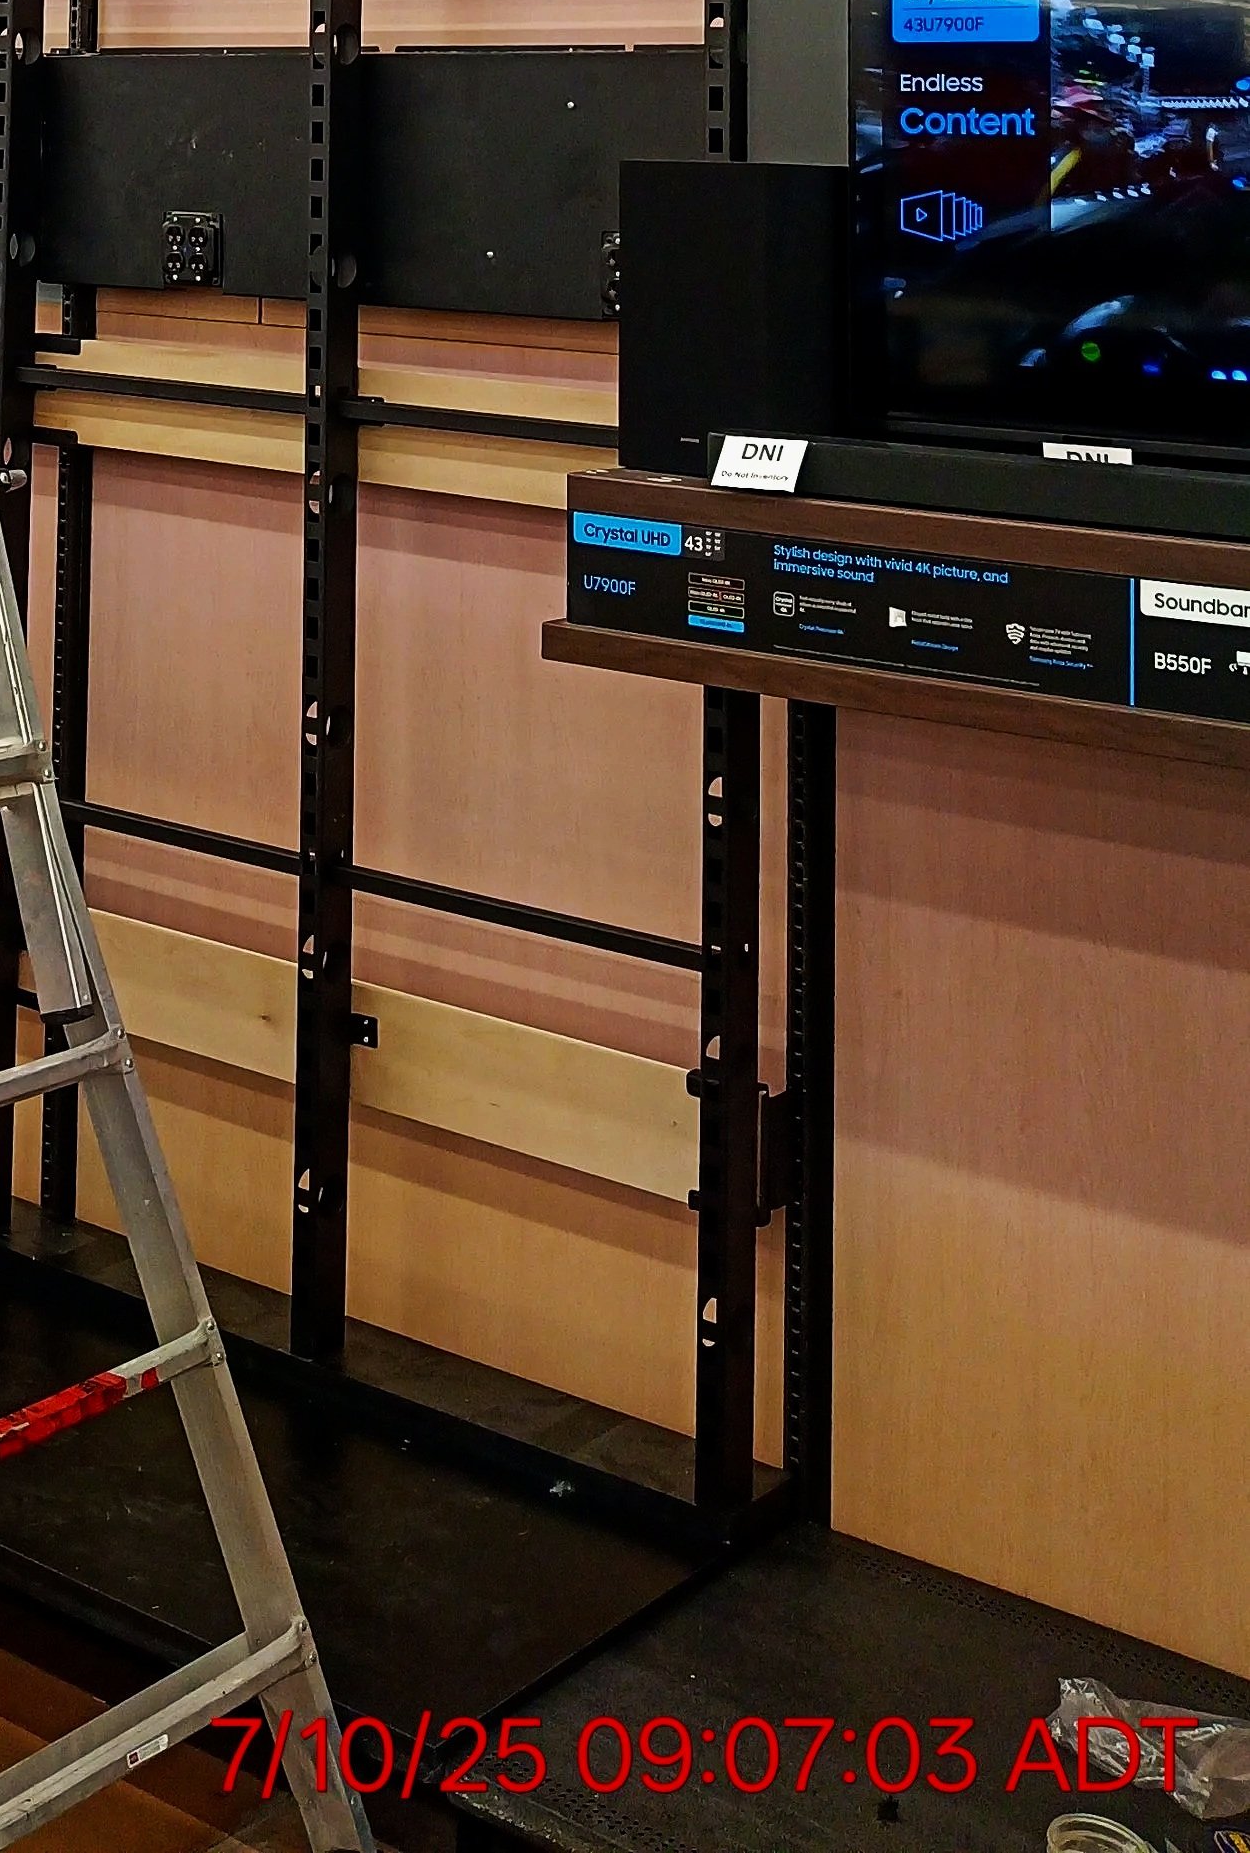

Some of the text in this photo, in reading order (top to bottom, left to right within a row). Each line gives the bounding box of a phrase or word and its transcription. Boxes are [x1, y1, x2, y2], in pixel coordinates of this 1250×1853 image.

[903, 14, 985, 33] 43U7900F
[899, 73, 984, 94] Endless
[899, 106, 1036, 137] Content
[741, 443, 784, 462] DNI
[583, 522, 671, 547] Crystal UHD
[684, 535, 704, 553] 43
[773, 544, 1009, 584] Stylish design with vivid 4K picture, and
[773, 559, 875, 583] immersive sound
[583, 574, 636, 596] U7900F
[1154, 592, 1250, 619] Soundbar
[1154, 651, 1212, 675] B550F
